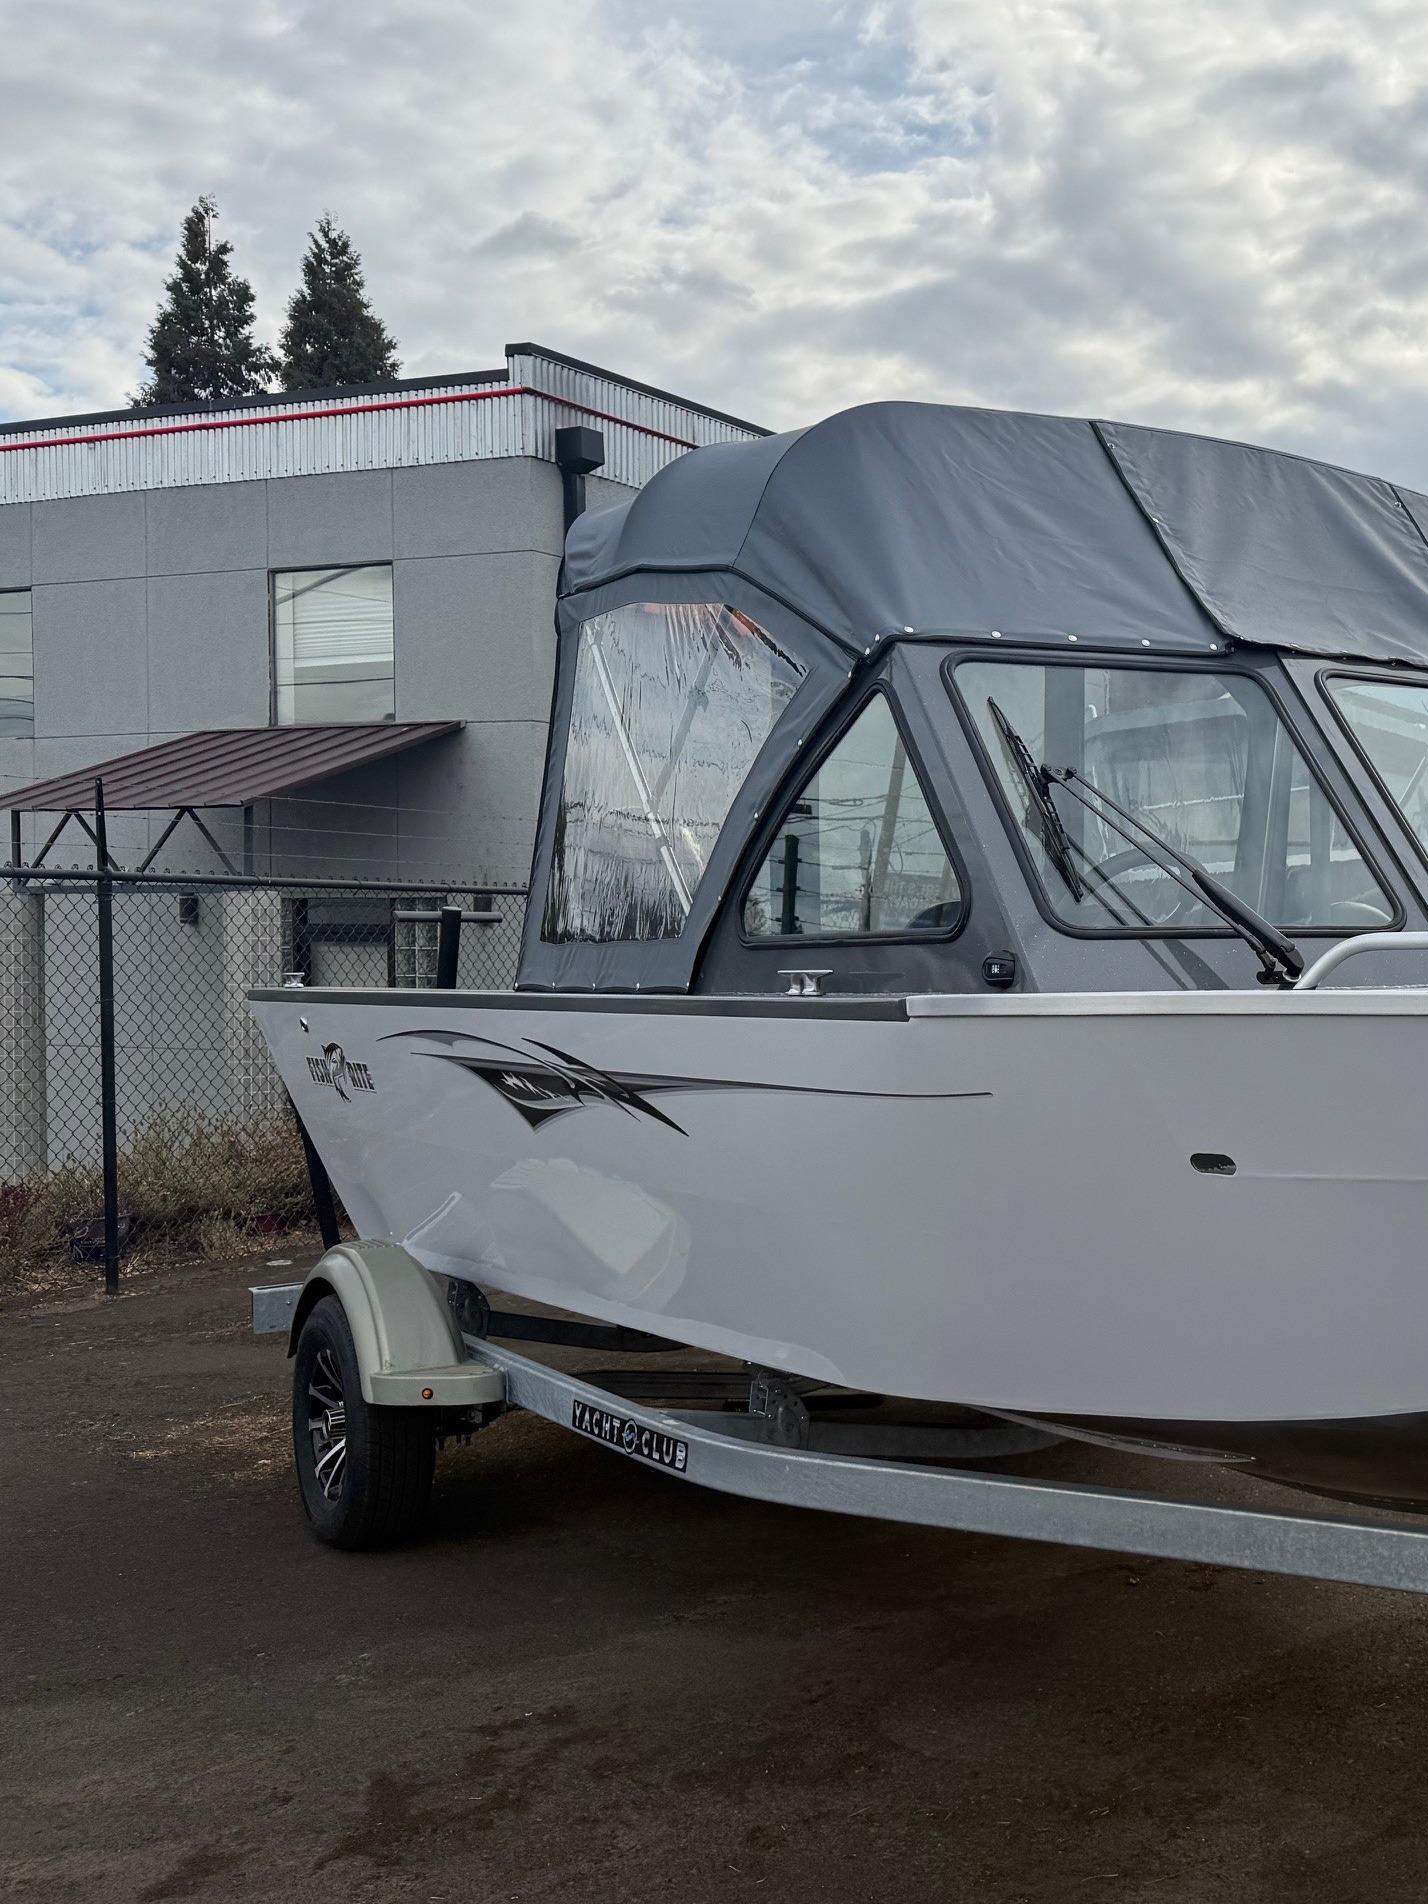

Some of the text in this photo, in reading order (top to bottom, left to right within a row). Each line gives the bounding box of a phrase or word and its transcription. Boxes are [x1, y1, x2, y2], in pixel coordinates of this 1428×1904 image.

[306, 1057, 375, 1090] FISH RITE
[574, 1401, 686, 1469] YACHT CLUB
